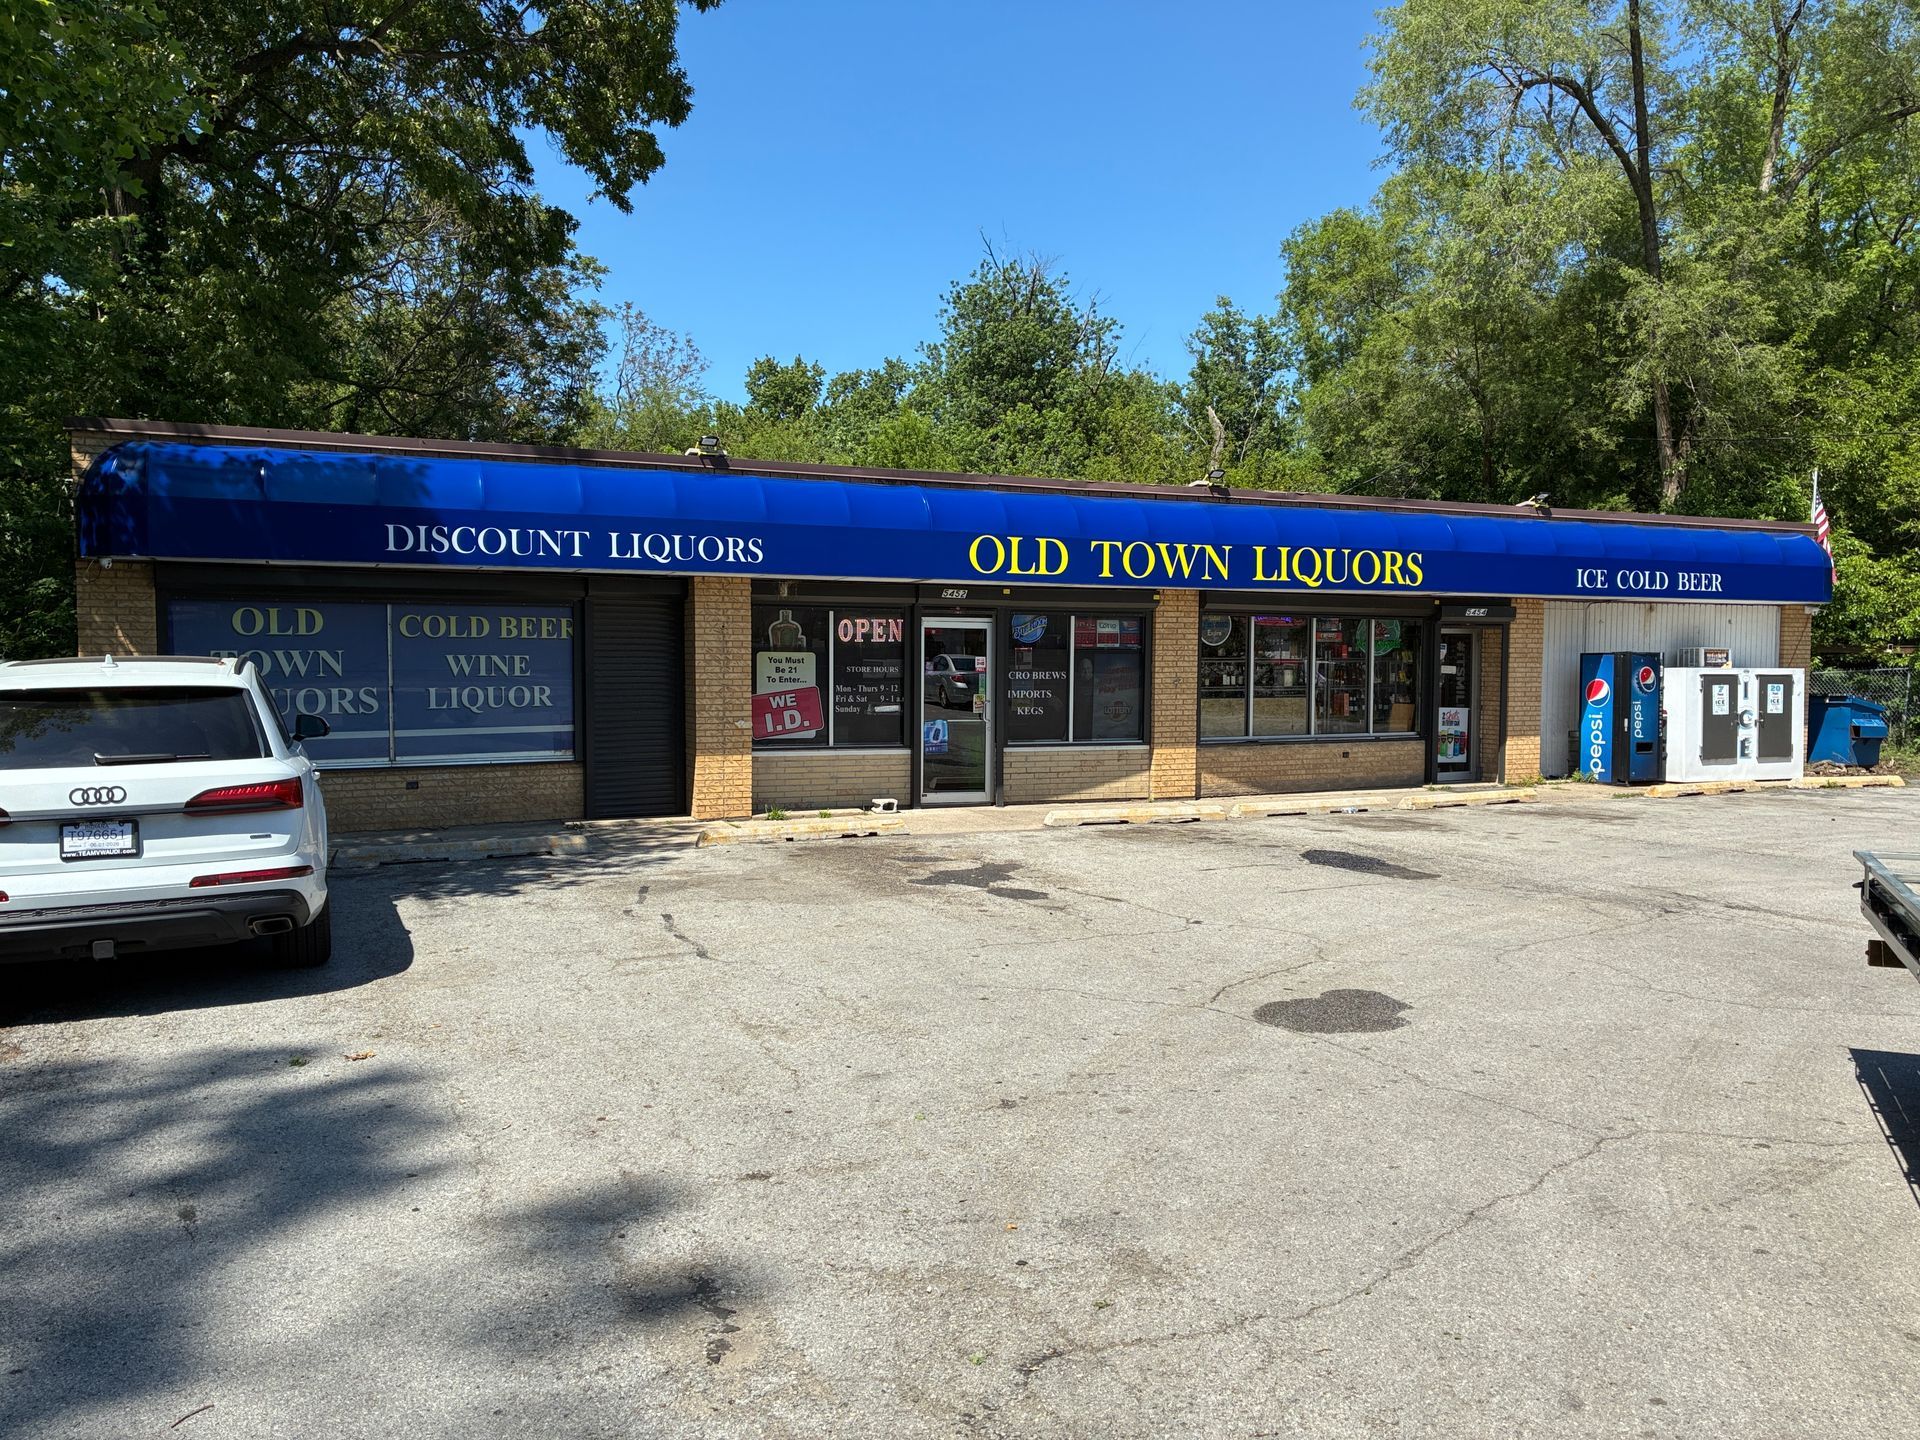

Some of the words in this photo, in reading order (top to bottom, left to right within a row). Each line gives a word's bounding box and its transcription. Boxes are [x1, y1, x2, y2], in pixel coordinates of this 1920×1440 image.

[384, 523, 590, 557] DISCOUNT
[608, 531, 764, 564] LIQUORS
[968, 534, 1069, 576] OLD
[1090, 540, 1232, 581] TOWN
[1252, 545, 1423, 588] LIQUORS
[1576, 568, 1608, 589] ICE
[1616, 570, 1669, 591] COLD
[1677, 572, 1723, 593] BEER
[942, 588, 968, 599] 5452
[1465, 608, 1488, 617] 5454
[231, 607, 325, 638] OLD
[399, 613, 490, 640] COLD
[499, 616, 573, 640] BEER
[838, 618, 904, 643] OPEN
[445, 654, 531, 677] WINE
[768, 656, 784, 665] You
[785, 656, 805, 664] Must
[775, 666, 786, 674] Be
[788, 666, 798, 674] 21
[846, 665, 872, 673] STORE
[873, 665, 899, 673] HOURS
[766, 676, 777, 684] To
[779, 676, 807, 684] Enter...
[1008, 671, 1030, 680] CRO
[1032, 671, 1067, 680] BREWS
[835, 684, 852, 692] Mon
[857, 684, 878, 692] Thurs
[880, 684, 885, 692] 9
[891, 684, 898, 692] 12
[426, 685, 553, 713] LIQUOR
[835, 695, 847, 703] Fri
[847, 695, 854, 703] &
[856, 695, 868, 703] Sat
[880, 695, 885, 703] 9
[1007, 689, 1052, 699] IMPORTS
[768, 693, 798, 709] WE
[835, 705, 861, 715] Sunday
[1017, 706, 1044, 715] KEGS
[765, 709, 810, 733] I.D.
[1633, 701, 1644, 738] pepsi
[1589, 712, 1606, 773] pepsi
[68, 830, 125, 841] T976651
